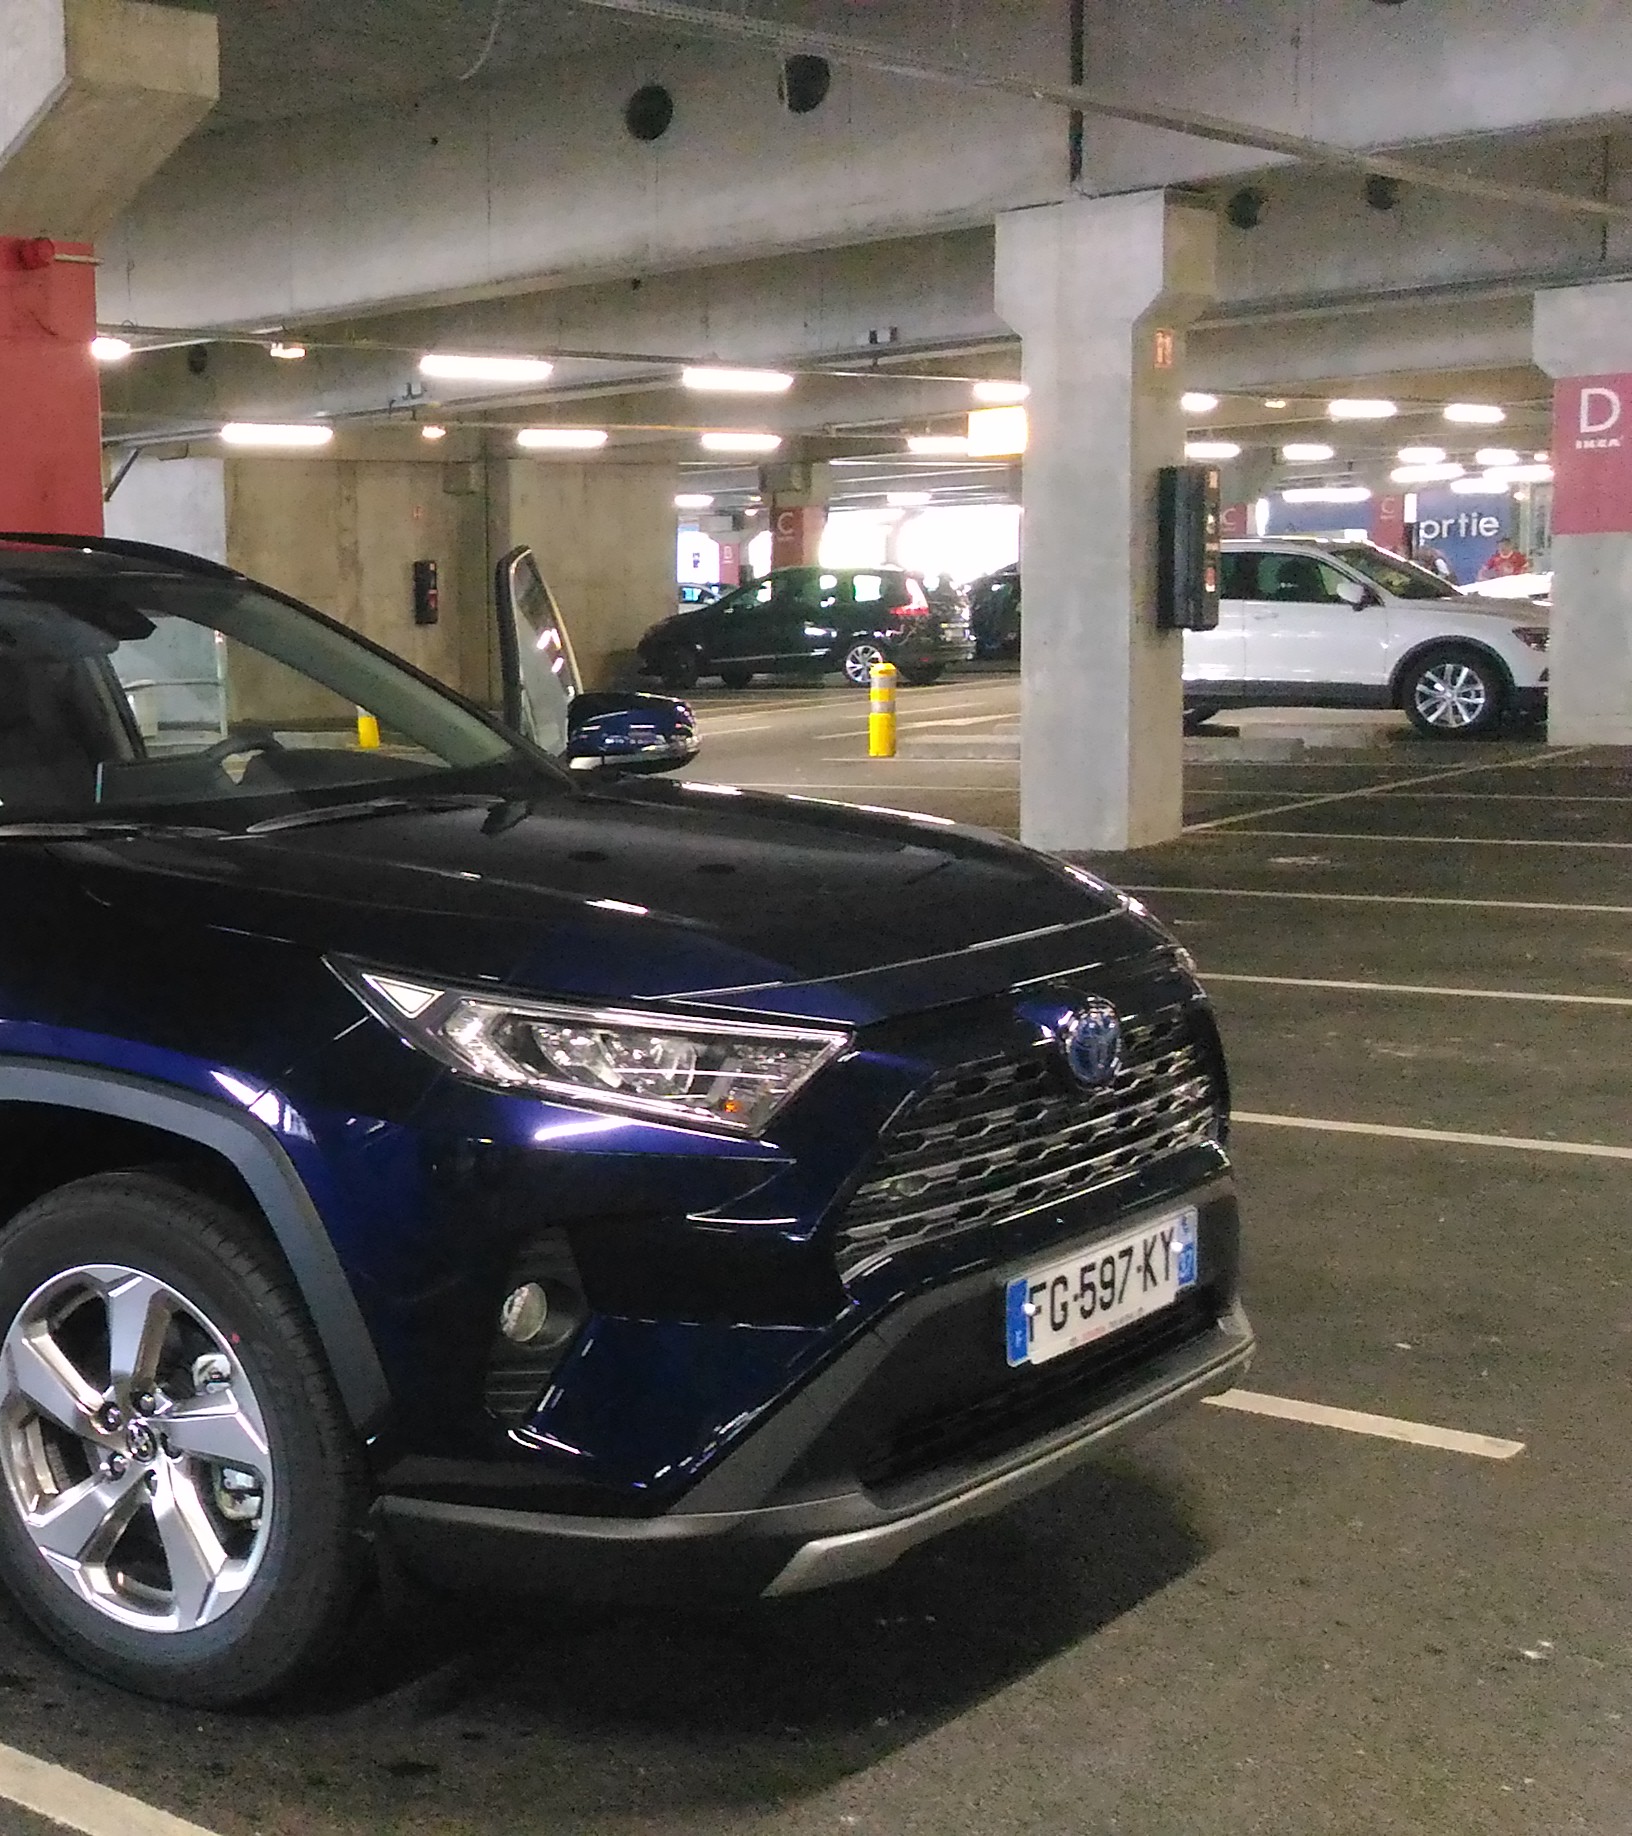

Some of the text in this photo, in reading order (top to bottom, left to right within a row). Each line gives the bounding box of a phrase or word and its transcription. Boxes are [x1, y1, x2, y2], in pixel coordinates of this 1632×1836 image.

[1580, 387, 1620, 433] D
[777, 511, 794, 534] C
[1419, 511, 1500, 541] ortie
[1029, 1226, 1175, 1342] FG-597-KY
